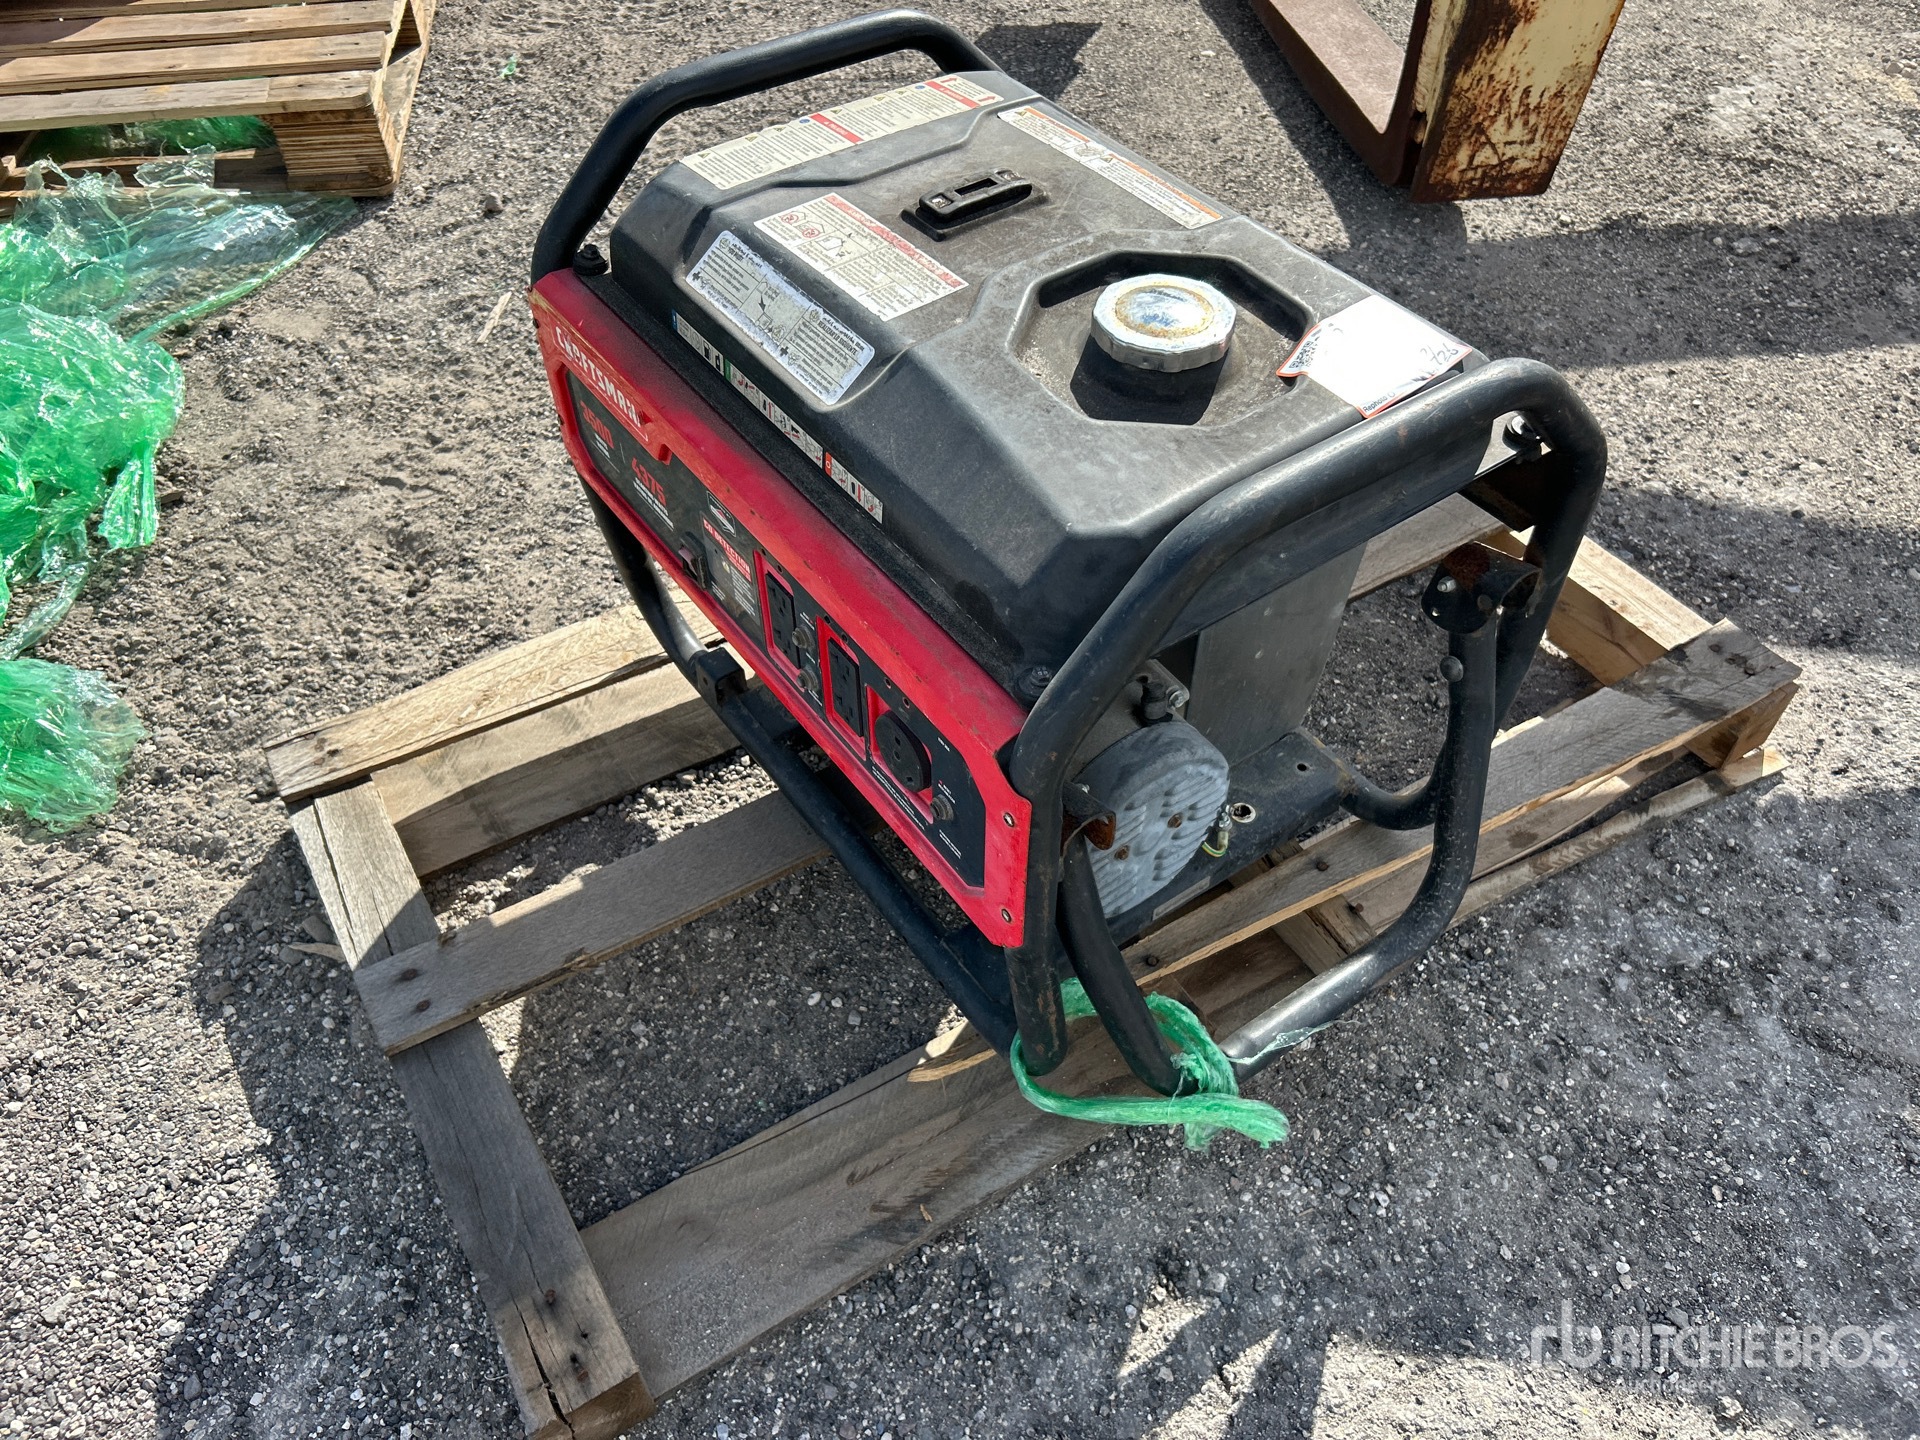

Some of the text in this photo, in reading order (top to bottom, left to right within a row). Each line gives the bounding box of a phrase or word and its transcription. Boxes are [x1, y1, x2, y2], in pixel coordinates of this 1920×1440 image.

[1362, 396, 1388, 412] Rephoto
[631, 457, 667, 507] 4375
[713, 529, 751, 575] DETECTION
